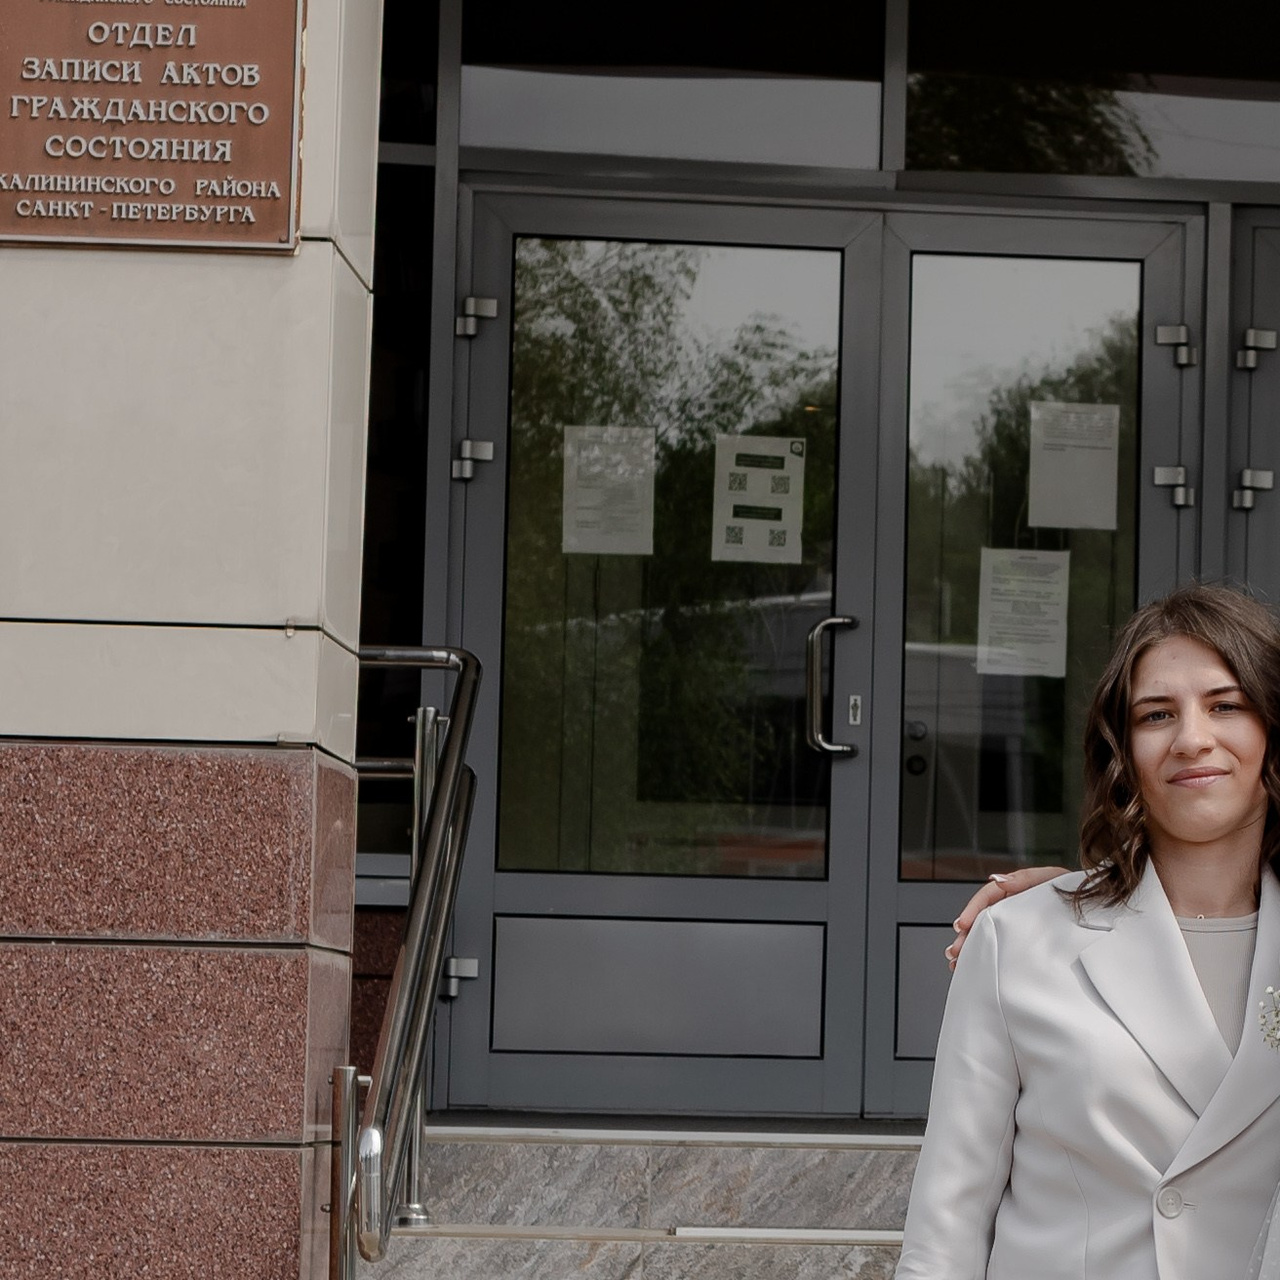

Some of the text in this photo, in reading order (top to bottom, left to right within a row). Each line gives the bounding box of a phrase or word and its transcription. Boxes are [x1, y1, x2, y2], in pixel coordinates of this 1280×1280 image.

[87, 21, 198, 48] ОТДЕЛ
[21, 57, 261, 86] ЗАПИСИ АКТОВ
[10, 95, 270, 125] ГРАЖДАНСКОГО
[45, 135, 233, 163] СОСТОЯНИЯ
[195, 175, 282, 198] РАЙОНА
